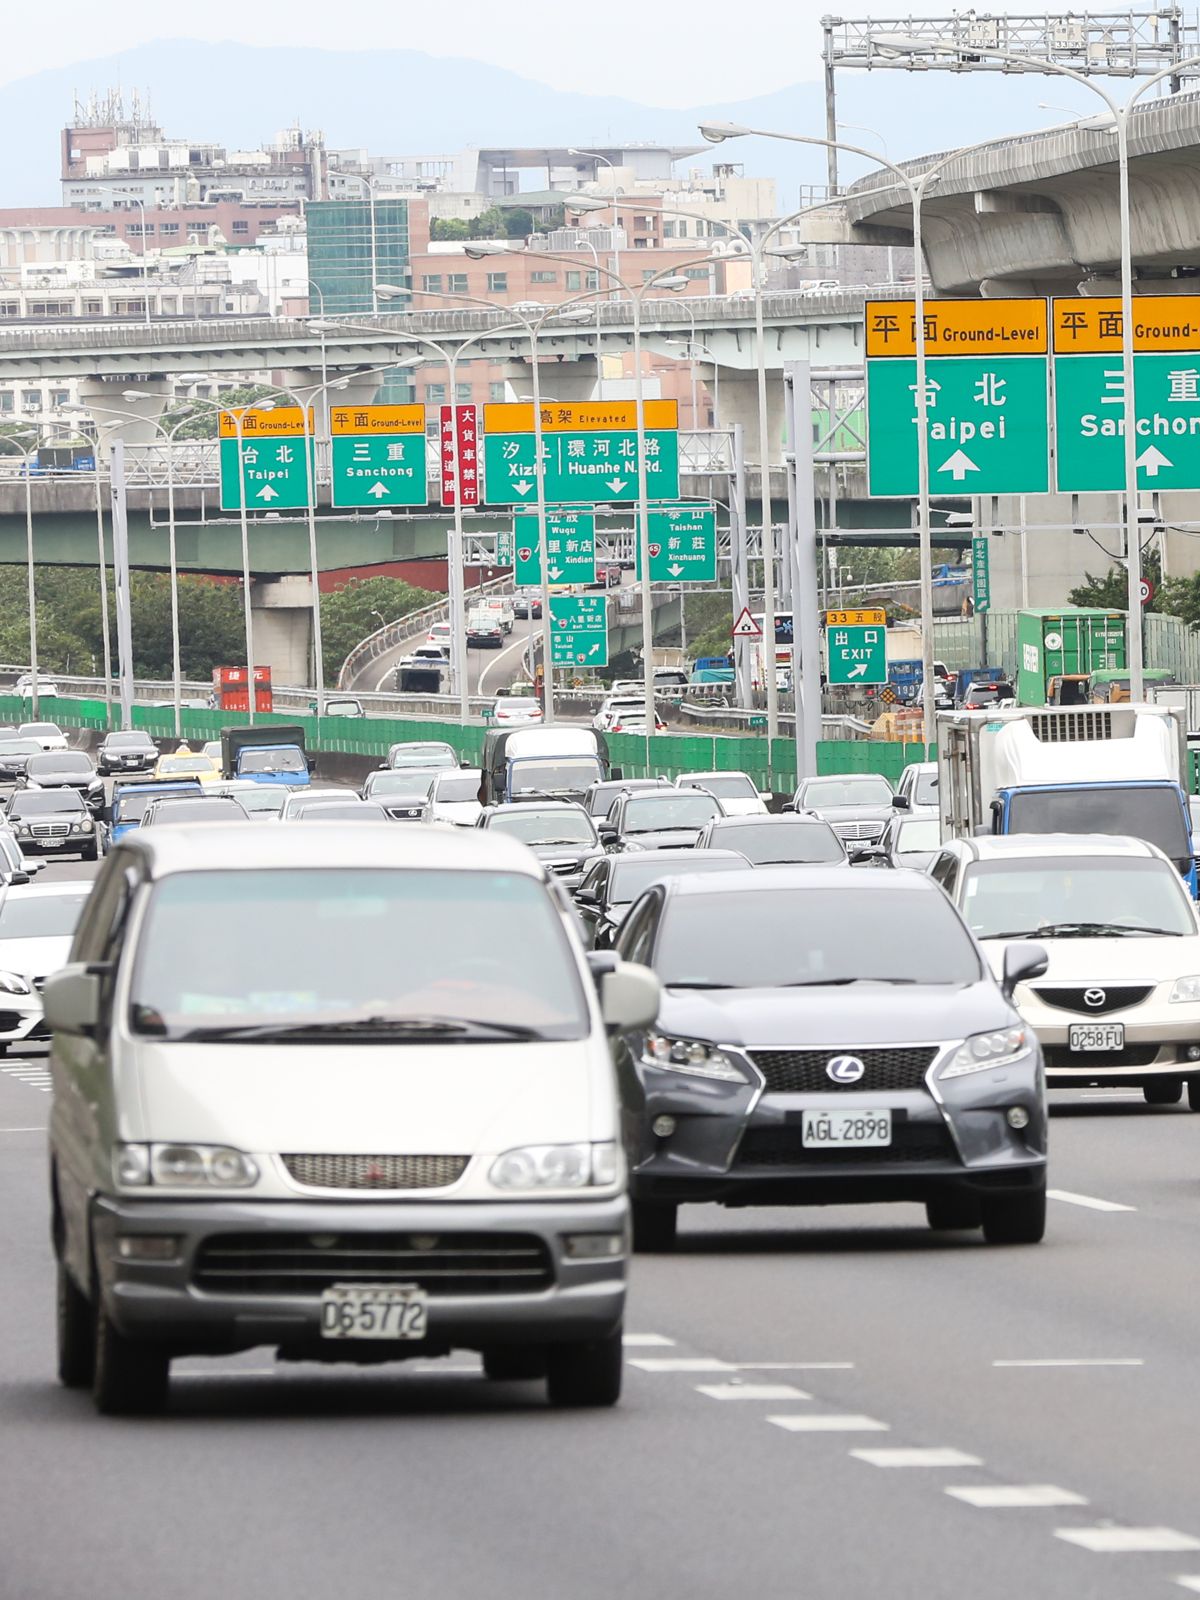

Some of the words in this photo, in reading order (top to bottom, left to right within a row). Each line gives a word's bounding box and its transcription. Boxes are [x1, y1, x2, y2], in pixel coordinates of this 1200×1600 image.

[872, 314, 938, 343] 平面
[942, 326, 1039, 342] Ground-Level
[1060, 311, 1124, 340] 平面
[908, 373, 1007, 407] 台北
[1101, 368, 1200, 404] 三重
[223, 415, 257, 430] 平面
[259, 420, 311, 430] Ground-Levl
[334, 412, 369, 428] 平面
[371, 418, 422, 427] Ground-Level
[540, 408, 572, 424] 高架
[579, 414, 626, 423] Elevated
[242, 445, 294, 464] 台北
[353, 442, 405, 461] 三重
[462, 409, 476, 500] 大貨車禁行
[568, 438, 660, 457] 環河北路
[248, 468, 289, 481] Taipei
[346, 466, 414, 477] Sanchong
[568, 461, 620, 475] Huanhe
[624, 460, 638, 473] N.
[644, 460, 663, 473] Rd.
[551, 526, 576, 536] Wugu
[669, 523, 703, 531] Taishan
[566, 539, 593, 552] 新店
[668, 536, 705, 550] 新莊
[565, 555, 593, 564] Xindian
[668, 553, 706, 562] Xinzhuang
[830, 613, 848, 622] 33
[855, 612, 882, 622] 五股
[835, 630, 878, 645] 出口
[841, 648, 872, 660] EXIT
